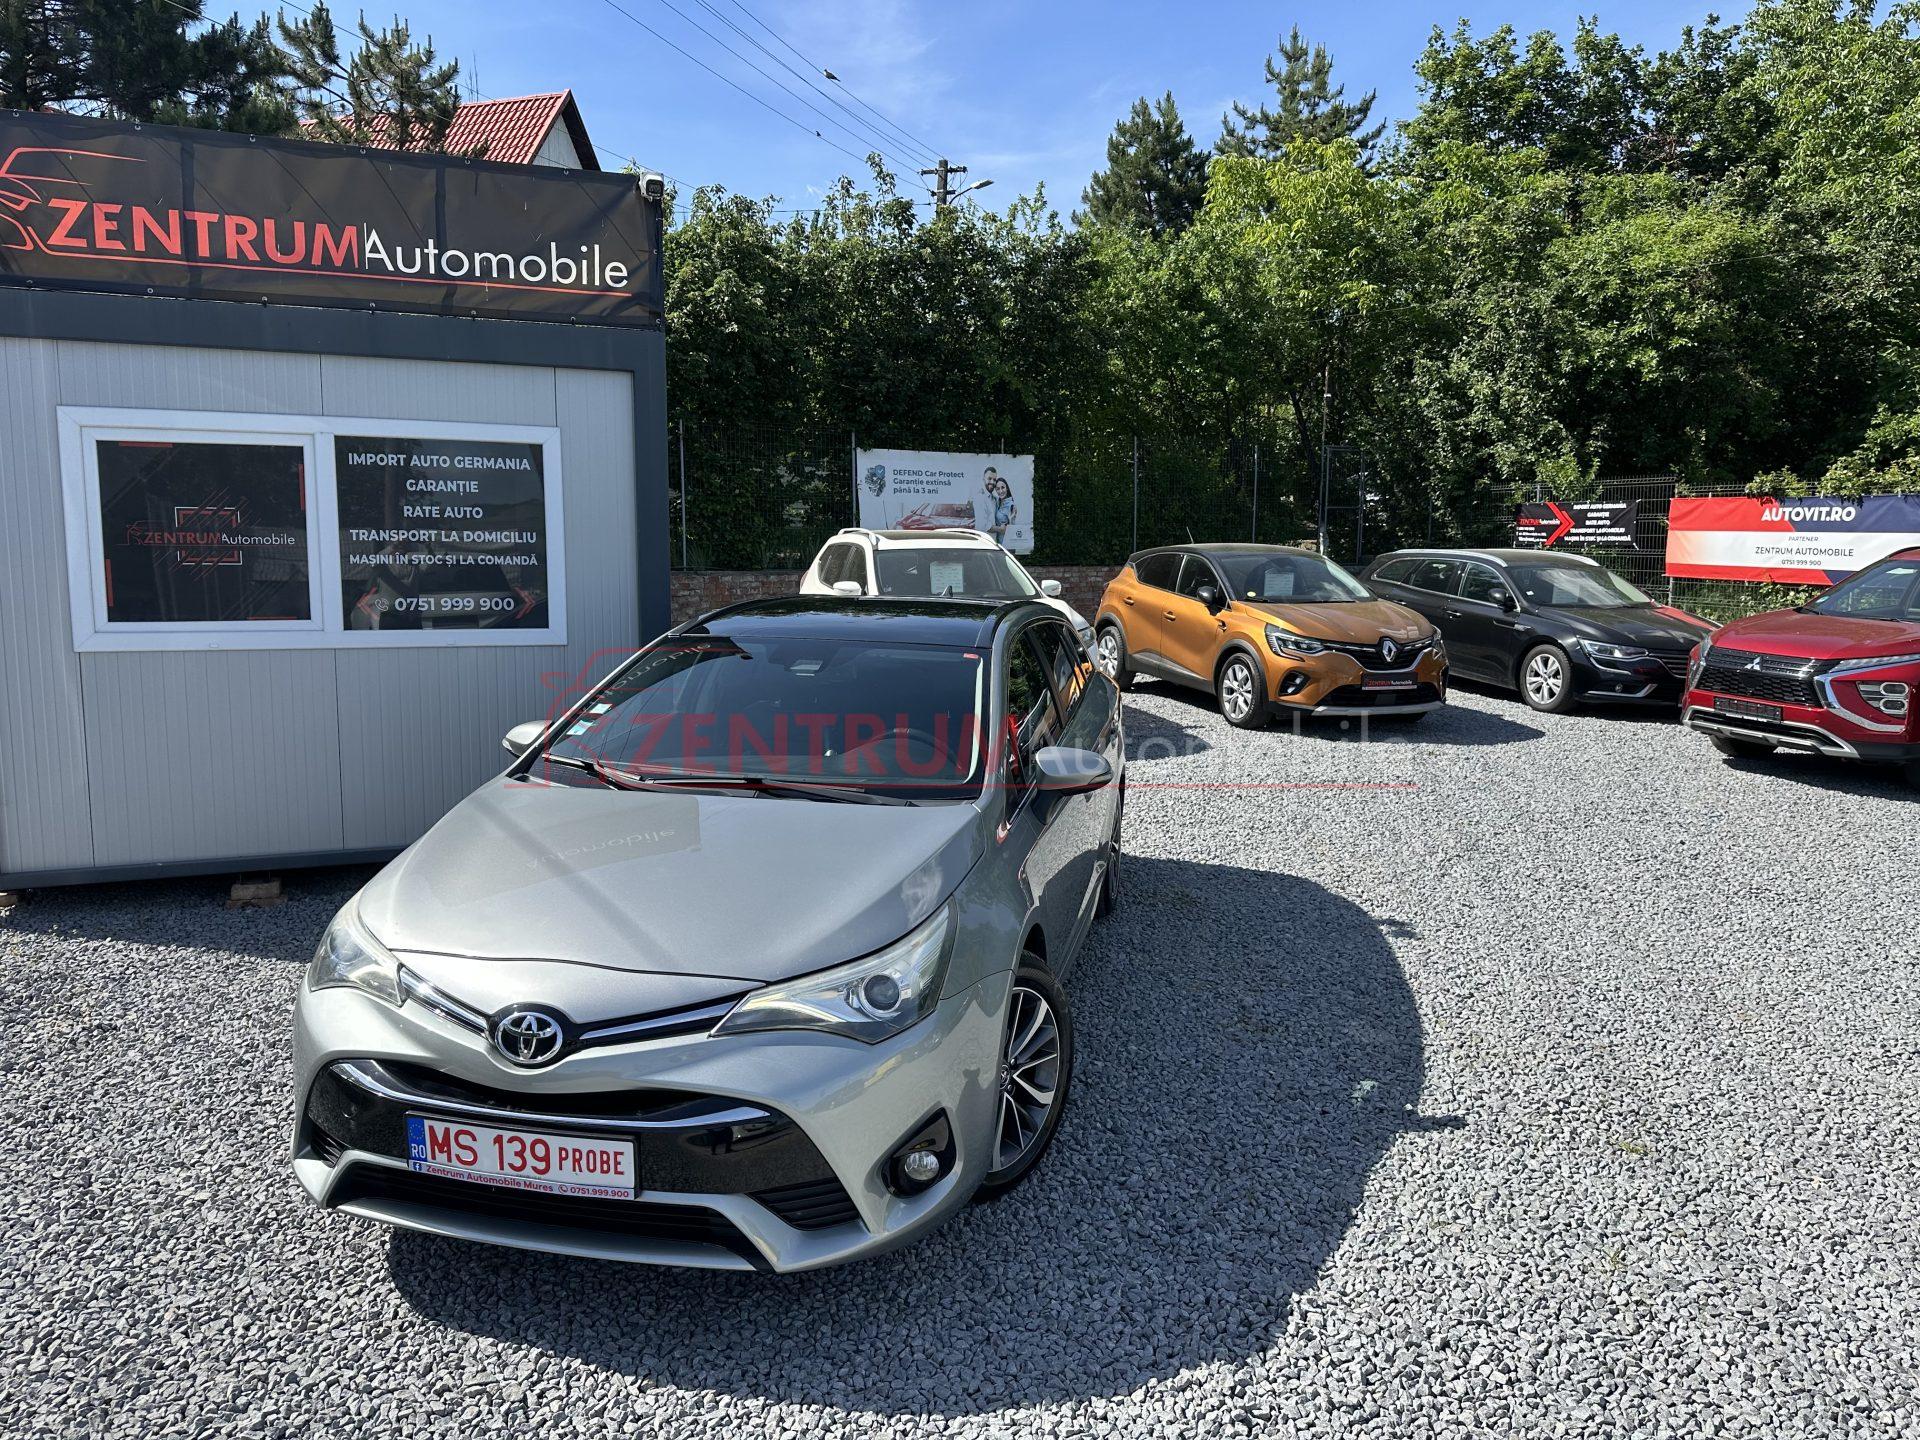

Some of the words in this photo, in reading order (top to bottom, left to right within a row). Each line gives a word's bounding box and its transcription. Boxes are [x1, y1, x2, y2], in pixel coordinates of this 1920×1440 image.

[46, 198, 359, 268] ZENTRUM
[363, 221, 629, 288] Automobile
[348, 452, 406, 466] IMPORT
[410, 455, 450, 468] AUTO
[454, 456, 531, 470] GERMANIA
[892, 469, 923, 477] DEFEND
[938, 470, 965, 478] Protect
[406, 479, 478, 496] GARANȚIE
[404, 506, 440, 518] RATE
[444, 507, 484, 518] AUTO
[1760, 506, 1856, 522] AUTOVIT.RO
[144, 532, 220, 544] ZENTRUM
[222, 532, 296, 545] Automobile
[350, 530, 437, 542] TRANSPORT
[441, 531, 460, 542] LA
[464, 532, 537, 544] DOMICILIU
[1755, 546, 1793, 556] ZENTRUM
[1795, 547, 1854, 557] AUTOMOBILE
[350, 554, 393, 568] MAȘINI
[396, 552, 408, 564] ÎN
[412, 555, 442, 565] STOC
[460, 555, 475, 565] LA
[478, 554, 538, 566] COMANDĂ
[394, 598, 436, 612] 0751
[440, 598, 475, 612] 999
[480, 598, 515, 612] 900
[410, 1143, 426, 1159] RO
[428, 1125, 478, 1166] MS
[493, 1134, 551, 1176] 139
[558, 1147, 625, 1176] PROBE
[426, 1165, 465, 1180] Zentrum
[466, 1172, 522, 1188] Automobile
[524, 1181, 554, 1192] Mures
[570, 1187, 629, 1198] 0751.999.900
